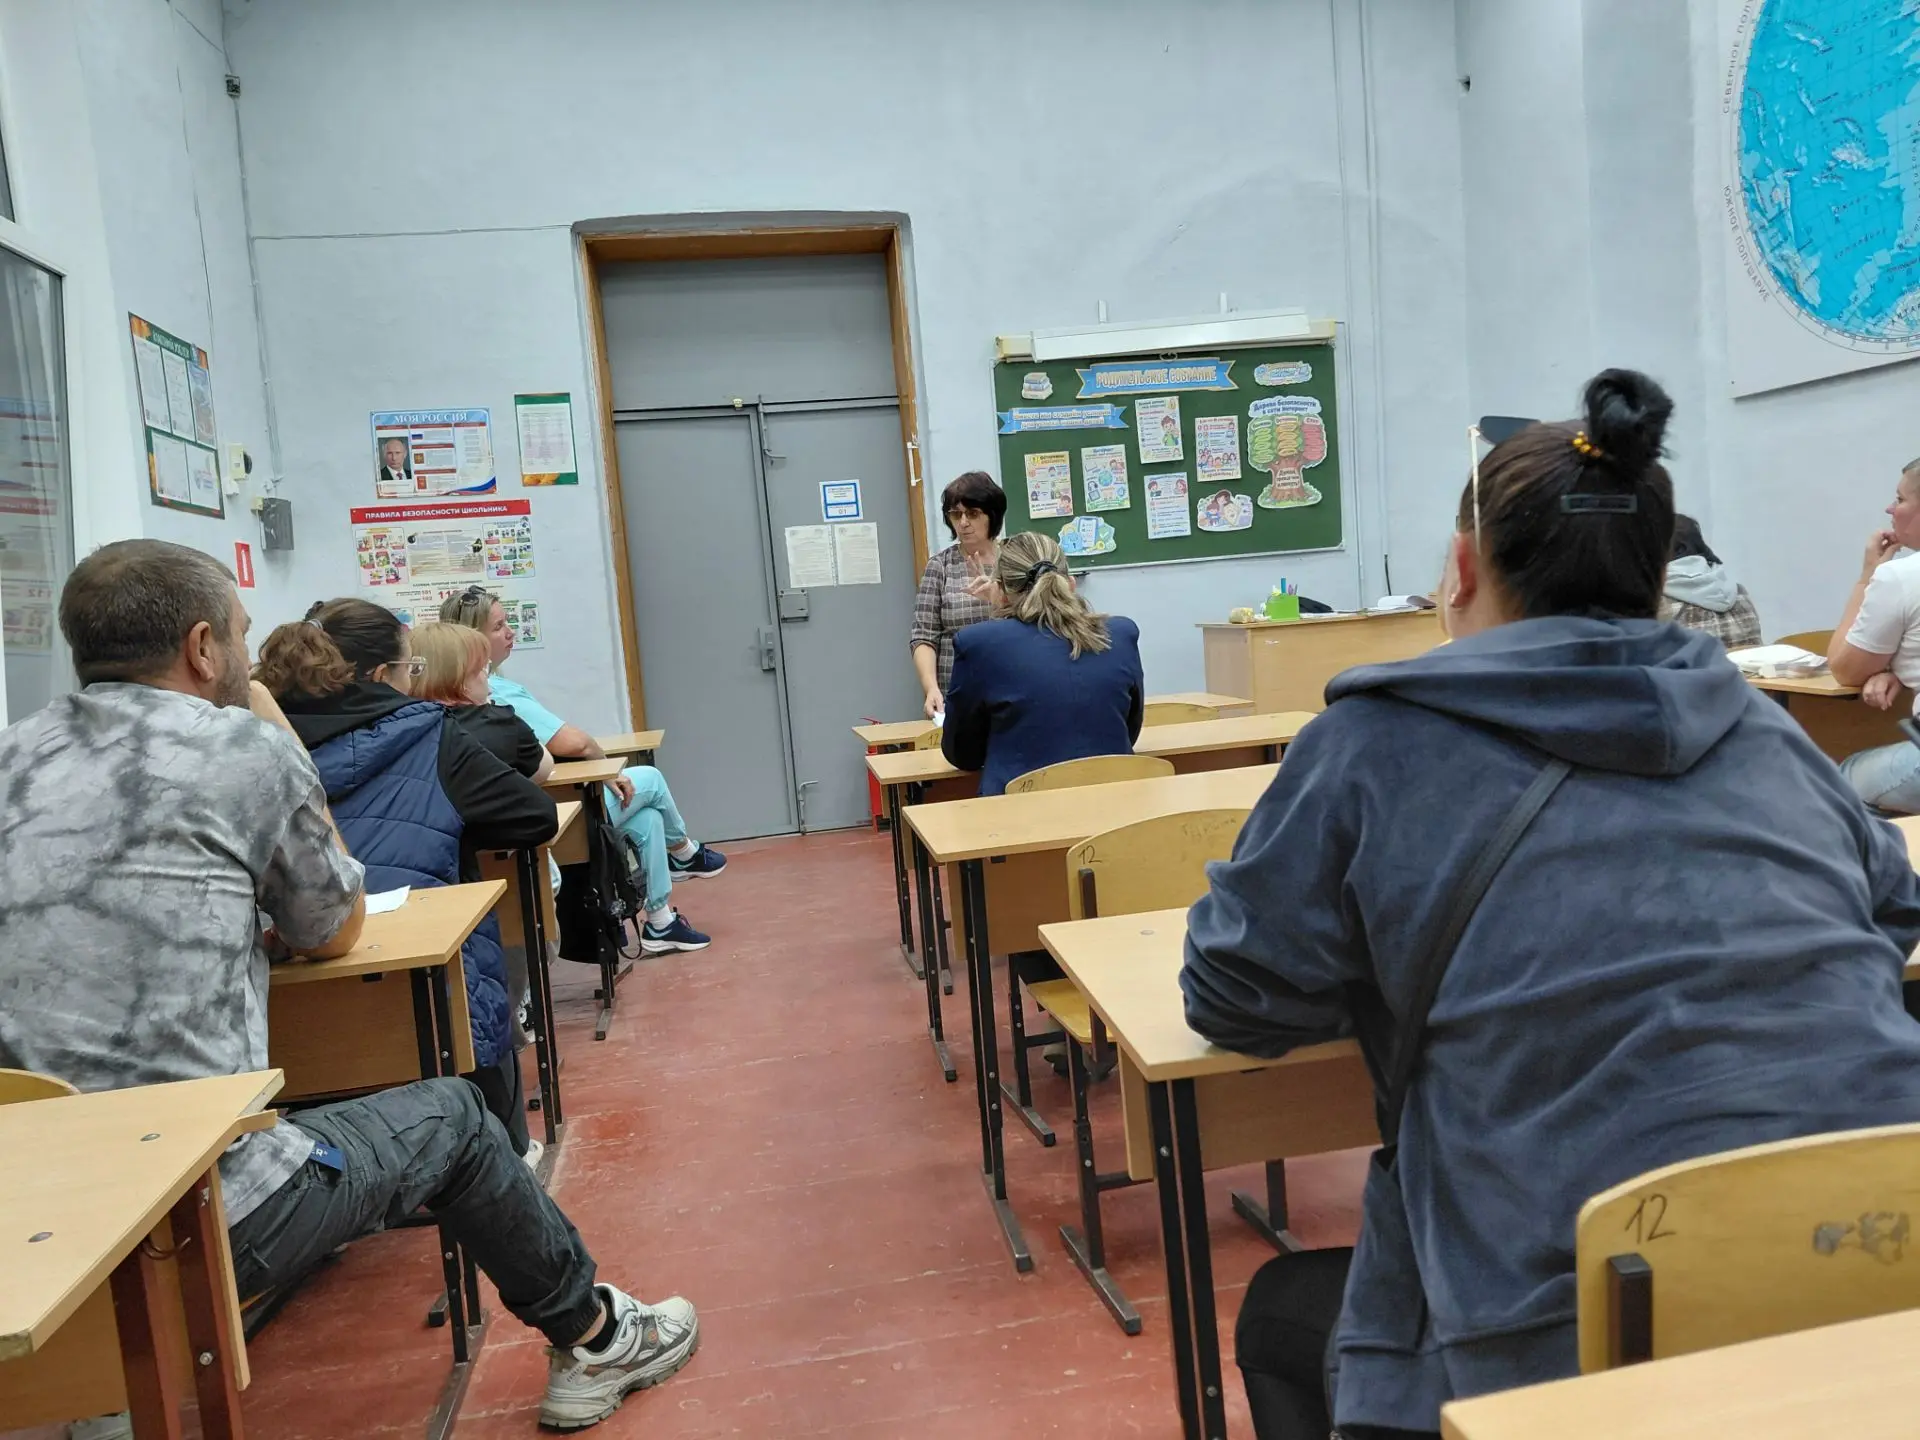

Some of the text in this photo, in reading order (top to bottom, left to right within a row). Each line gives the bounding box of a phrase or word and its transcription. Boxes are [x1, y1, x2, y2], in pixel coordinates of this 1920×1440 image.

[1723, 185, 1771, 302] ЮЖНОЕ ПОЛУШАРИЕ
[1095, 365, 1217, 389] РОДИТЕЛЬСКОЕ СОБРАНИЕ
[394, 412, 467, 423] МОЯ РОССИЯ
[365, 505, 508, 519] ПРАВИЛА БЕЗОПАСНОСТИ ШКОЛЬНИКА
[1078, 845, 1101, 864] 12
[1624, 1193, 1677, 1245] 12
